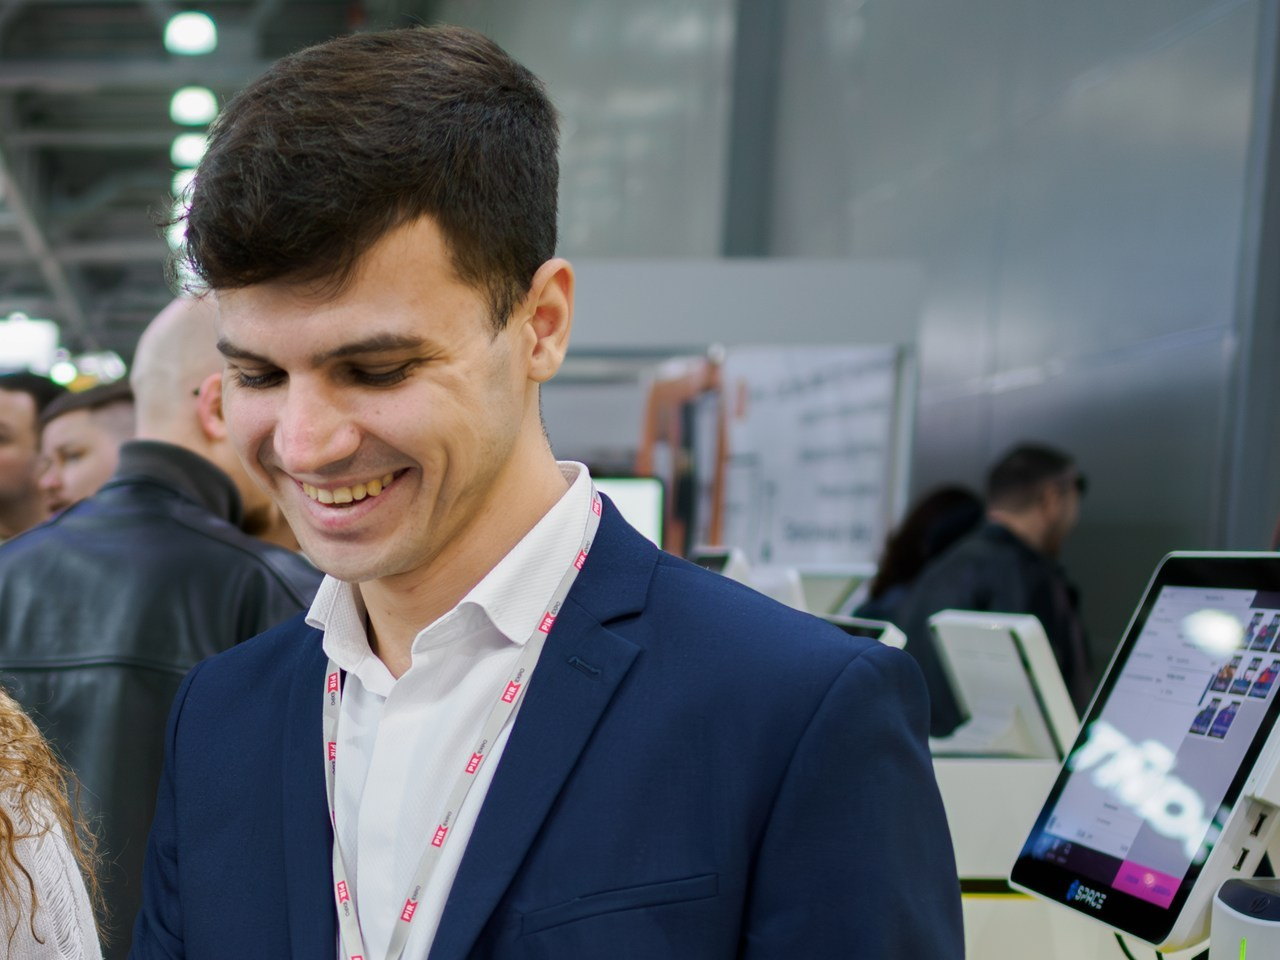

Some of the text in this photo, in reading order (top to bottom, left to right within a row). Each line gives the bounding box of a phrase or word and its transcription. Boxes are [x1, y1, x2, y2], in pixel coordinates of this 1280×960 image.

[541, 616, 554, 632] PIR
[505, 685, 517, 702] PIR
[467, 756, 479, 773] PIR
[434, 829, 445, 846] PIR
[1074, 884, 1108, 910] SPACE
[403, 904, 415, 921] PIR
